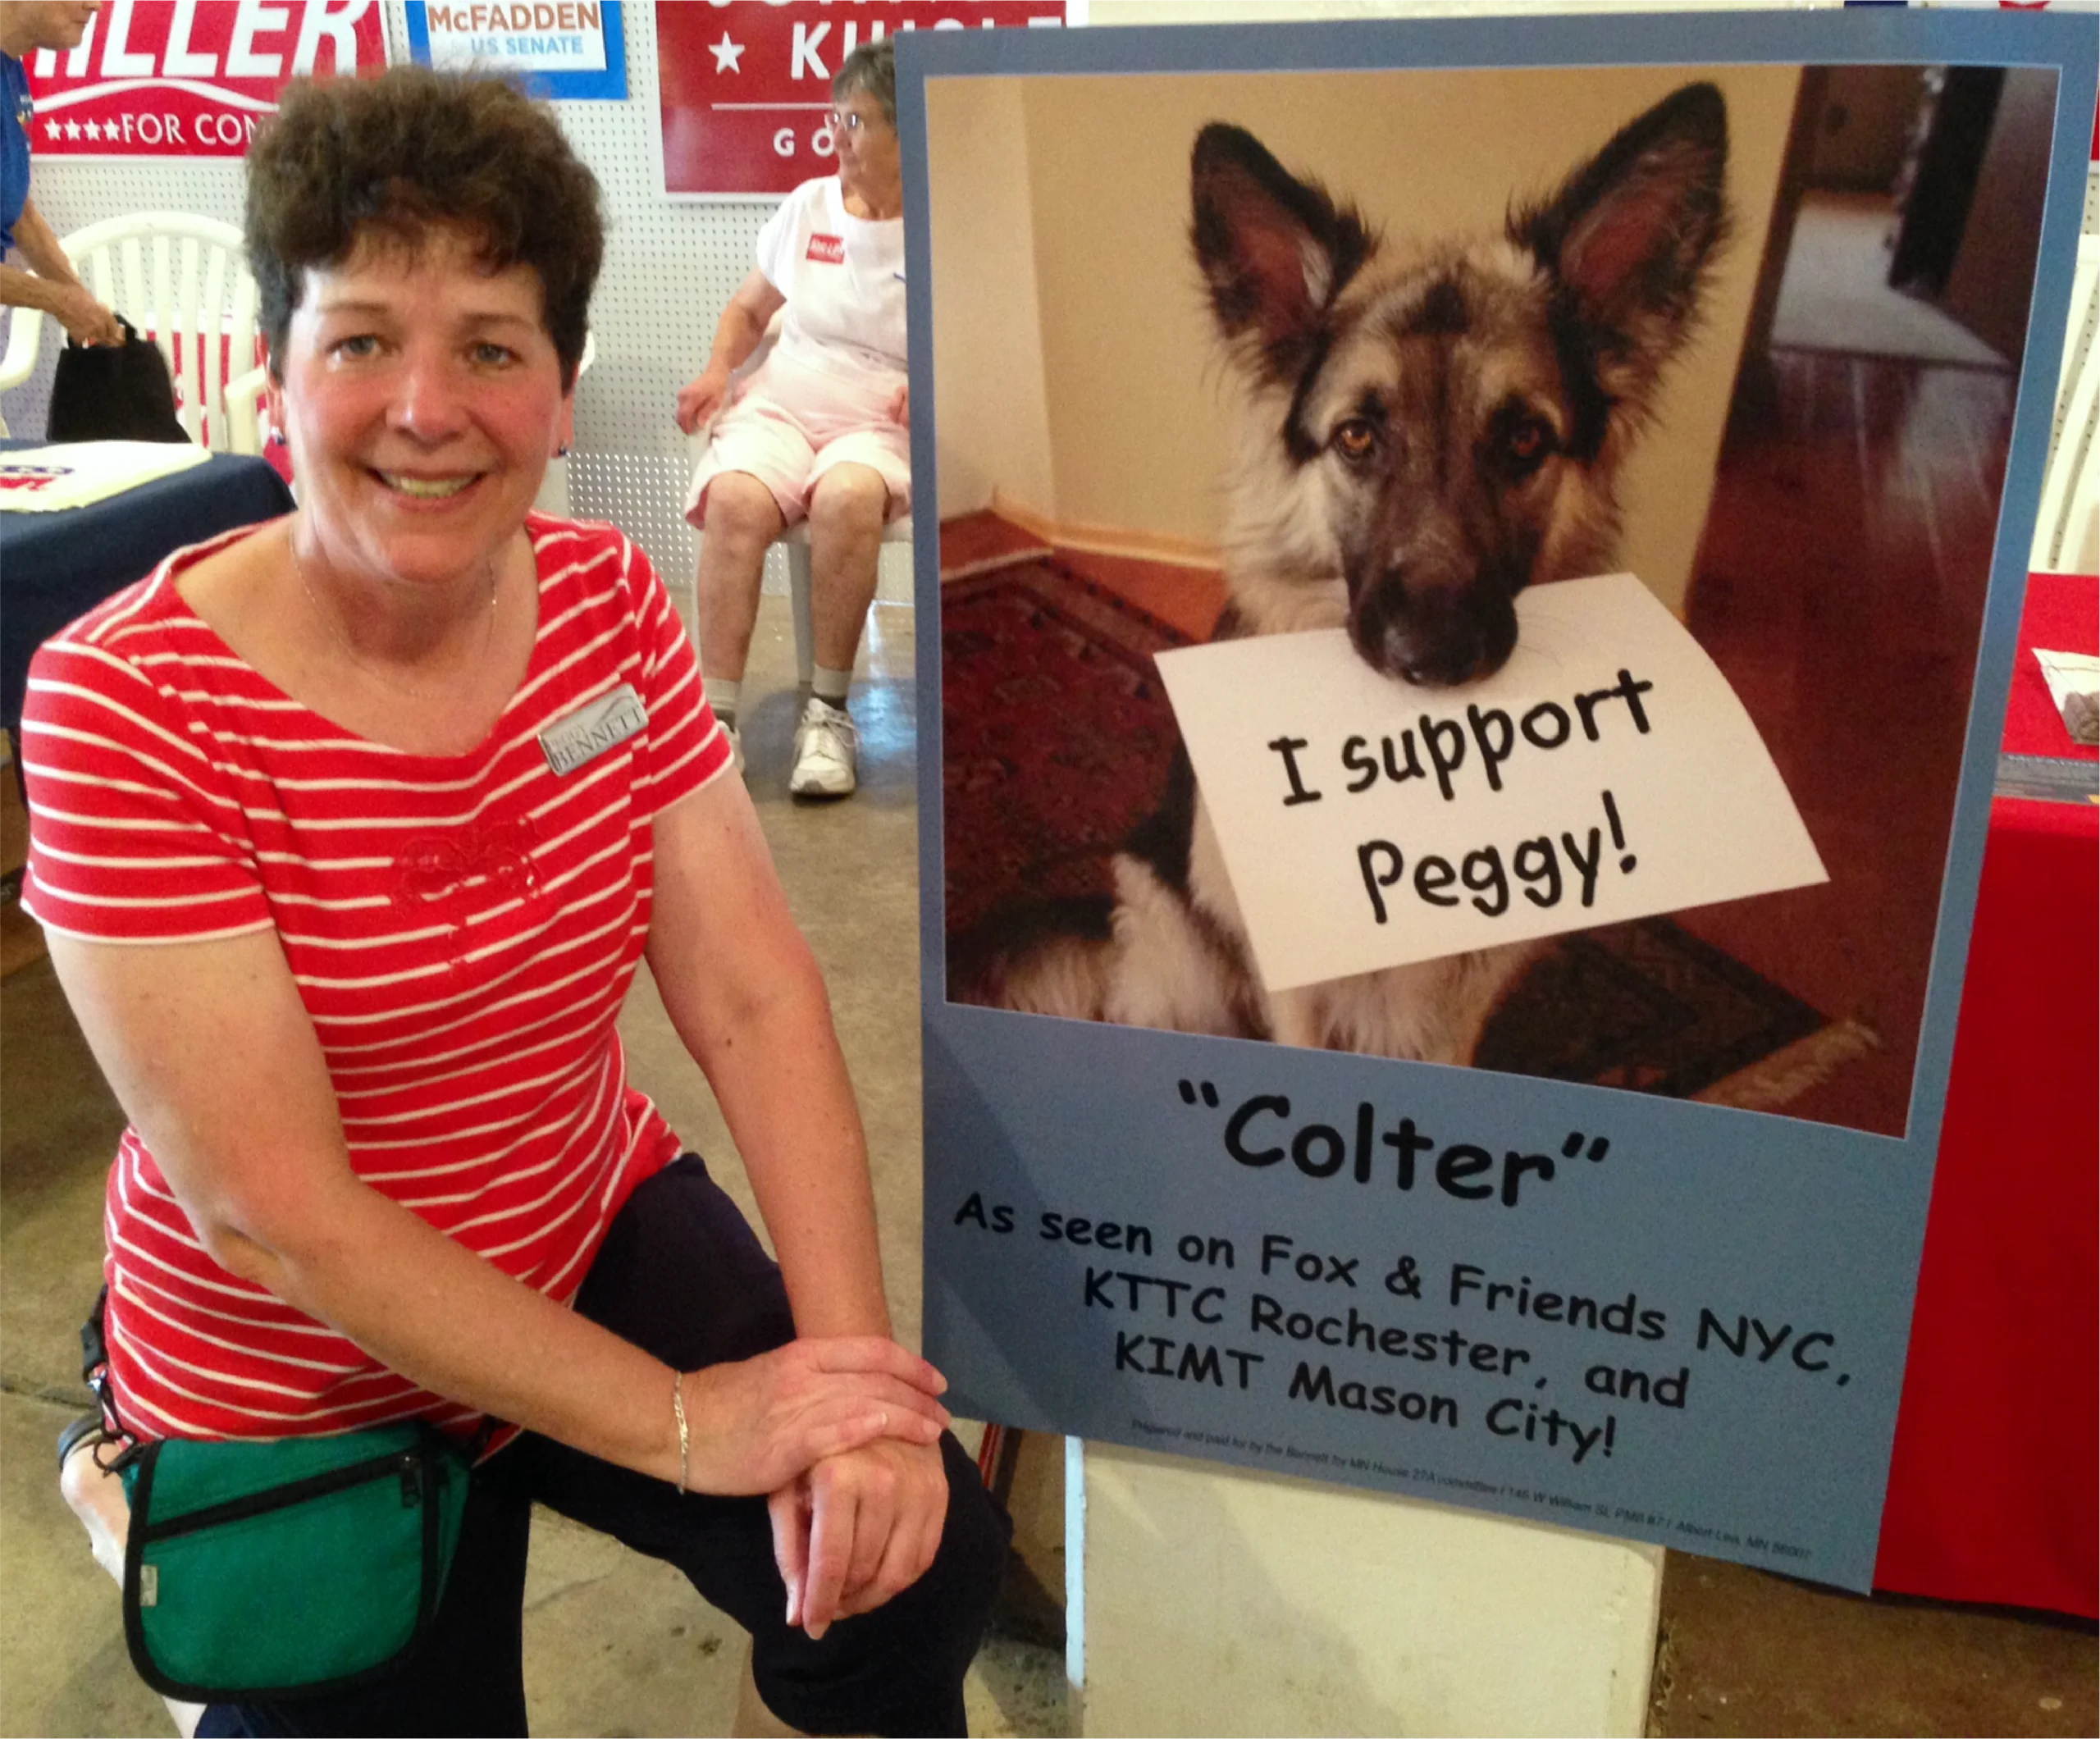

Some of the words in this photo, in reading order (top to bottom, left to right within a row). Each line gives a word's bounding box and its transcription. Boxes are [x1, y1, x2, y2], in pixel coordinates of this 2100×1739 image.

[427, 2, 600, 32] McFADDEN
[471, 36, 499, 55] US
[505, 35, 583, 55] SENATE
[122, 112, 186, 144] FOR
[1268, 737, 1322, 806] I
[1342, 669, 1652, 801] support
[1358, 791, 1637, 924] Peggy!
[1178, 1079, 1610, 1207] "Colter"
[954, 1191, 1015, 1233] As
[1039, 1212, 1152, 1256] seen
[1178, 1235, 1234, 1269] on
[1262, 1235, 1358, 1287] Fox
[1385, 1253, 1422, 1299] &
[1450, 1263, 1666, 1340] Friends
[1696, 1308, 1851, 1386] NYC,
[1084, 1267, 1226, 1323] KTTC
[1252, 1294, 1548, 1389] Rochester,
[1585, 1367, 1690, 1408] and
[1115, 1330, 1264, 1390] KIMT
[1289, 1362, 1458, 1428] Mason
[1486, 1399, 1617, 1464] City!
[1184, 1431, 1204, 1441] and
[1267, 1443, 1284, 1455] the
[1350, 1458, 1370, 1471] MN
